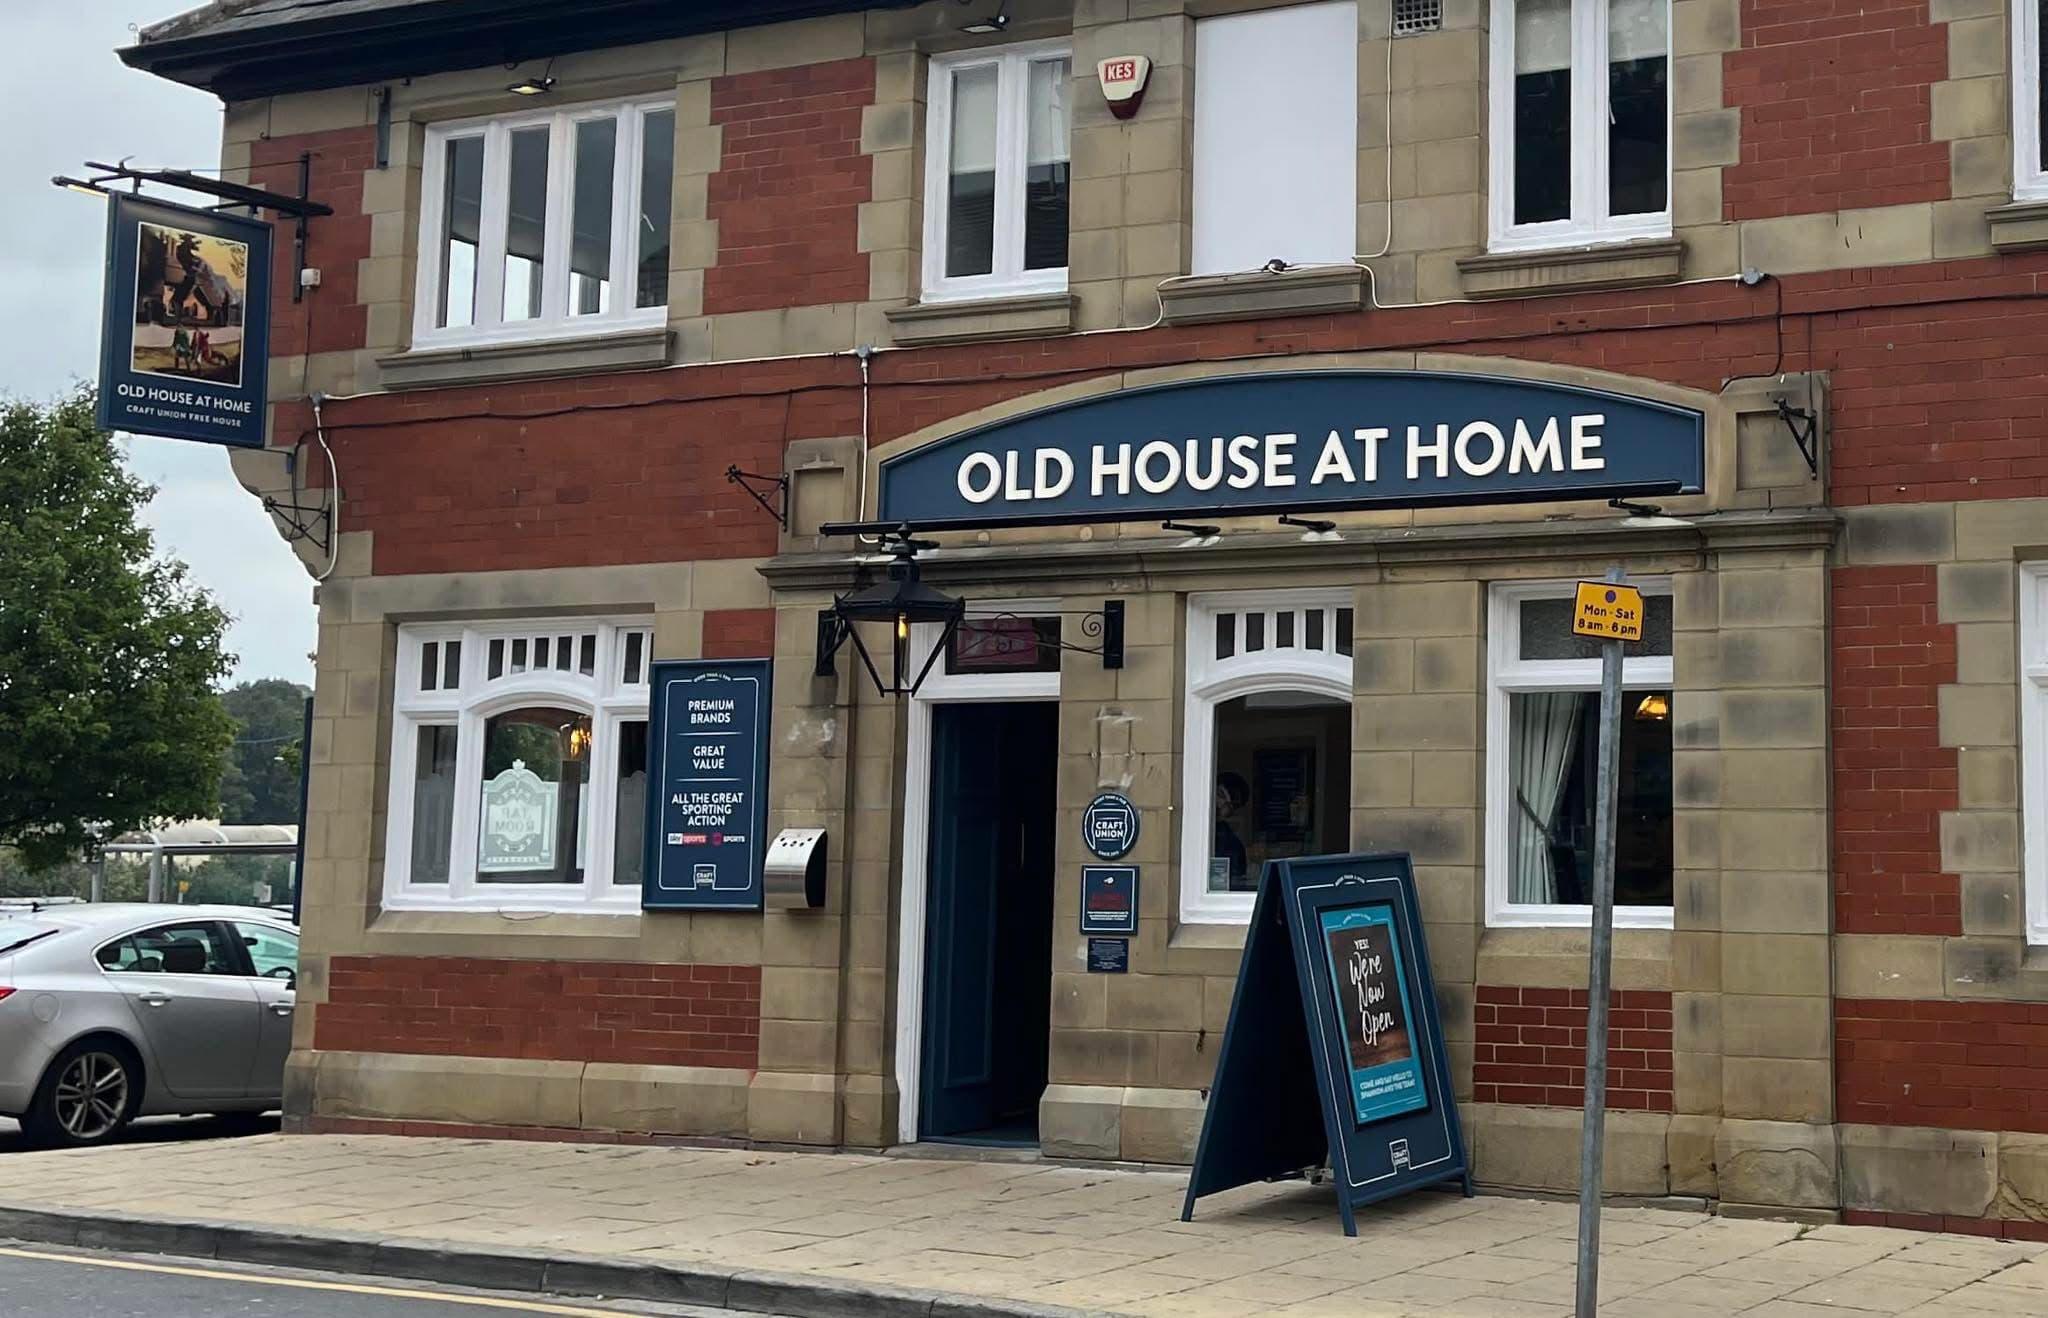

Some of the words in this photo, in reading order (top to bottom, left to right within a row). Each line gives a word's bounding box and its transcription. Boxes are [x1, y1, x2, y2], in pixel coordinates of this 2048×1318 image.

[1107, 63, 1132, 80] KES
[118, 384, 146, 398] OLD
[149, 388, 193, 404] HOUSE
[196, 395, 212, 408] AT
[214, 399, 252, 413] HOME
[126, 405, 154, 415] CRAFT
[157, 409, 187, 419] UNION
[188, 414, 210, 423] FREE
[212, 417, 241, 427] HOUSE
[957, 447, 1075, 503] OLD
[1091, 433, 1297, 497] HOUSE
[1310, 427, 1389, 485] AT
[1406, 413, 1606, 480] HOME
[1584, 604, 1606, 616] Mon
[1616, 608, 1634, 620] Sat
[688, 700, 734, 710] PREMIUM
[690, 713, 731, 724] BRANDS
[693, 745, 725, 756] GREAT
[692, 758, 724, 769] VALUE
[672, 793, 689, 804] ALL
[691, 793, 710, 803] THE
[711, 793, 744, 803] GREAT
[682, 804, 732, 814] SPORTING
[688, 816, 725, 826] ACTION
[1350, 951, 1382, 985] We're
[1358, 976, 1384, 1012] Now
[1362, 1010, 1394, 1046] Open
